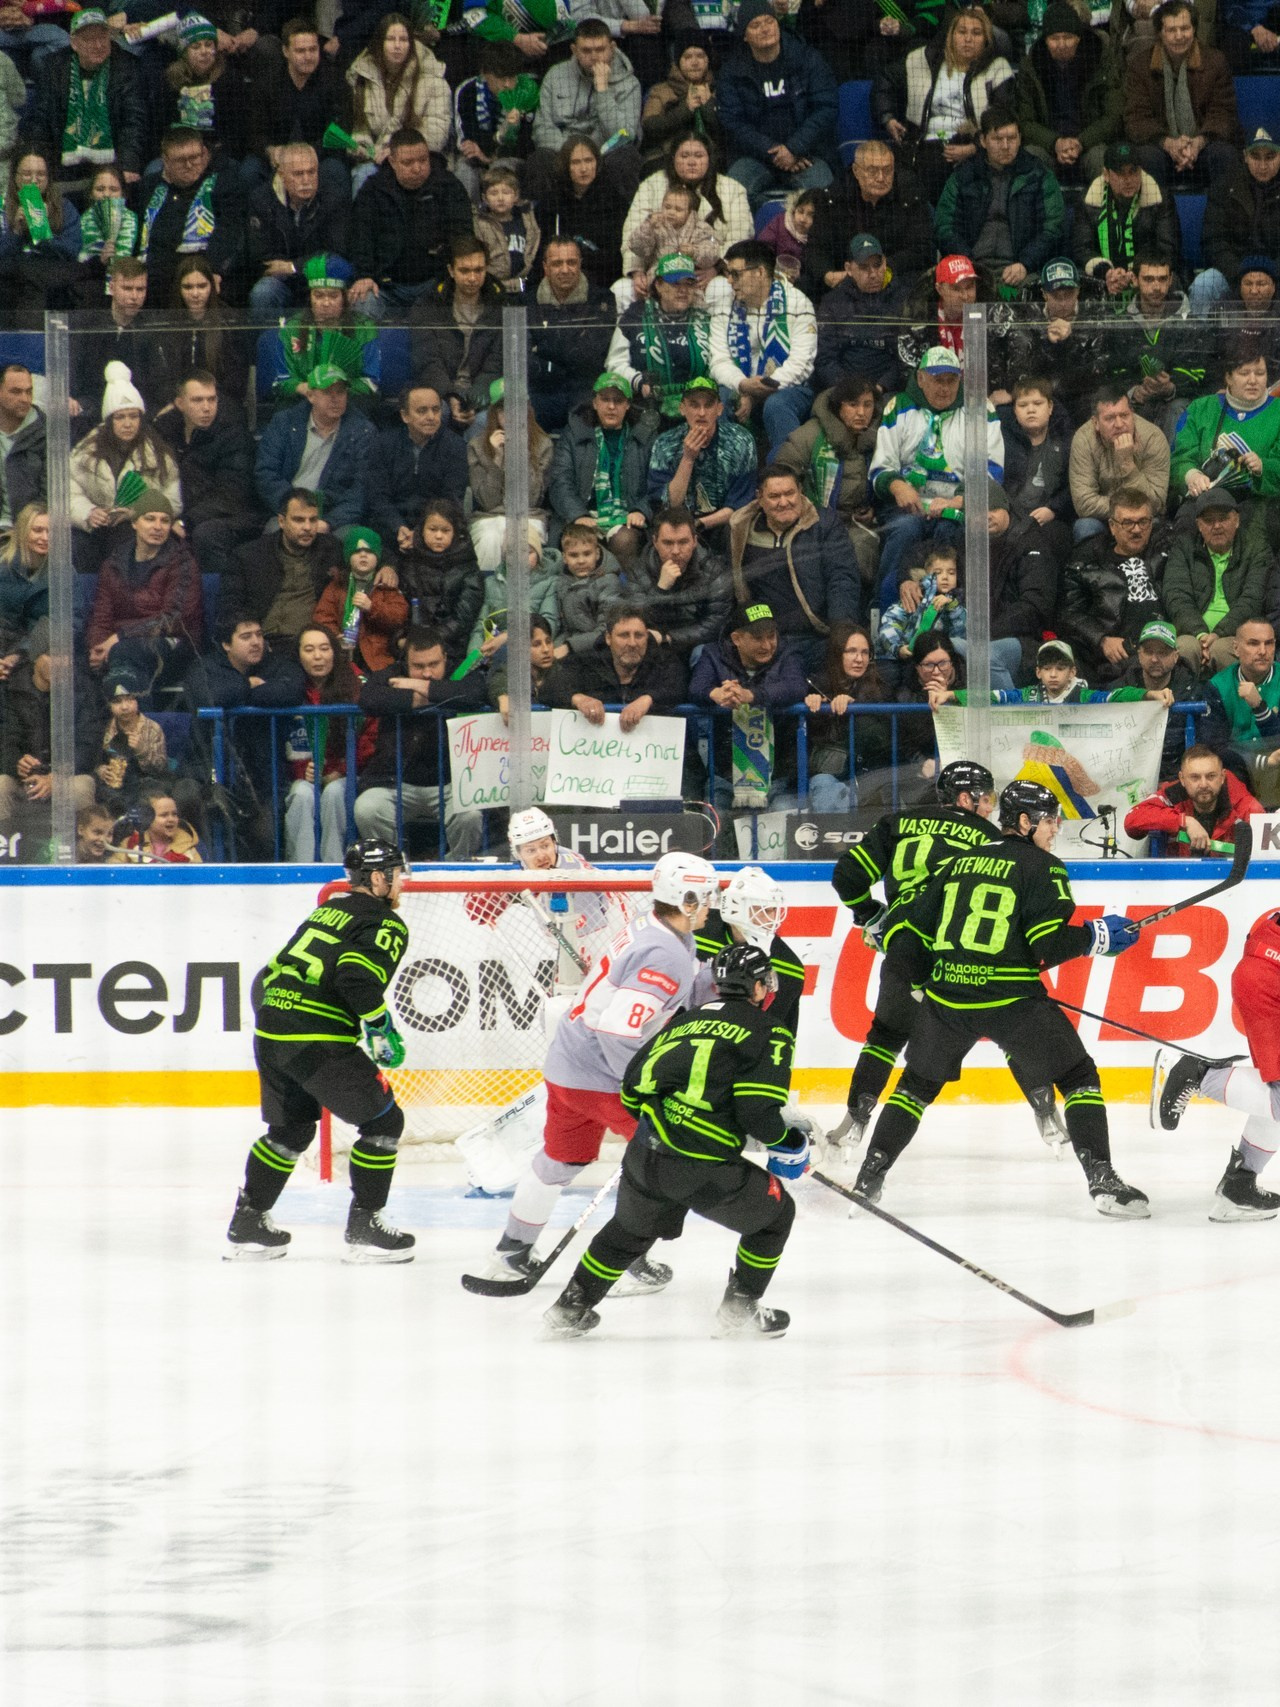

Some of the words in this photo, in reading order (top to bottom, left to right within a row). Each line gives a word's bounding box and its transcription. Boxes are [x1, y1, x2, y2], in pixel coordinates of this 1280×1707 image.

[551, 773, 616, 796] стена
[571, 822, 673, 854] Haier
[951, 857, 1016, 879] STEWART
[307, 906, 353, 931] REMOV
[932, 882, 1017, 955] 18
[374, 928, 404, 963] 65
[944, 963, 994, 975] САДОВОЕ
[944, 975, 988, 986] КОЛЬЦО
[627, 1002, 656, 1029] 87
[494, 1094, 536, 1127] TRUE
[959, 1259, 1014, 1293] CCM
